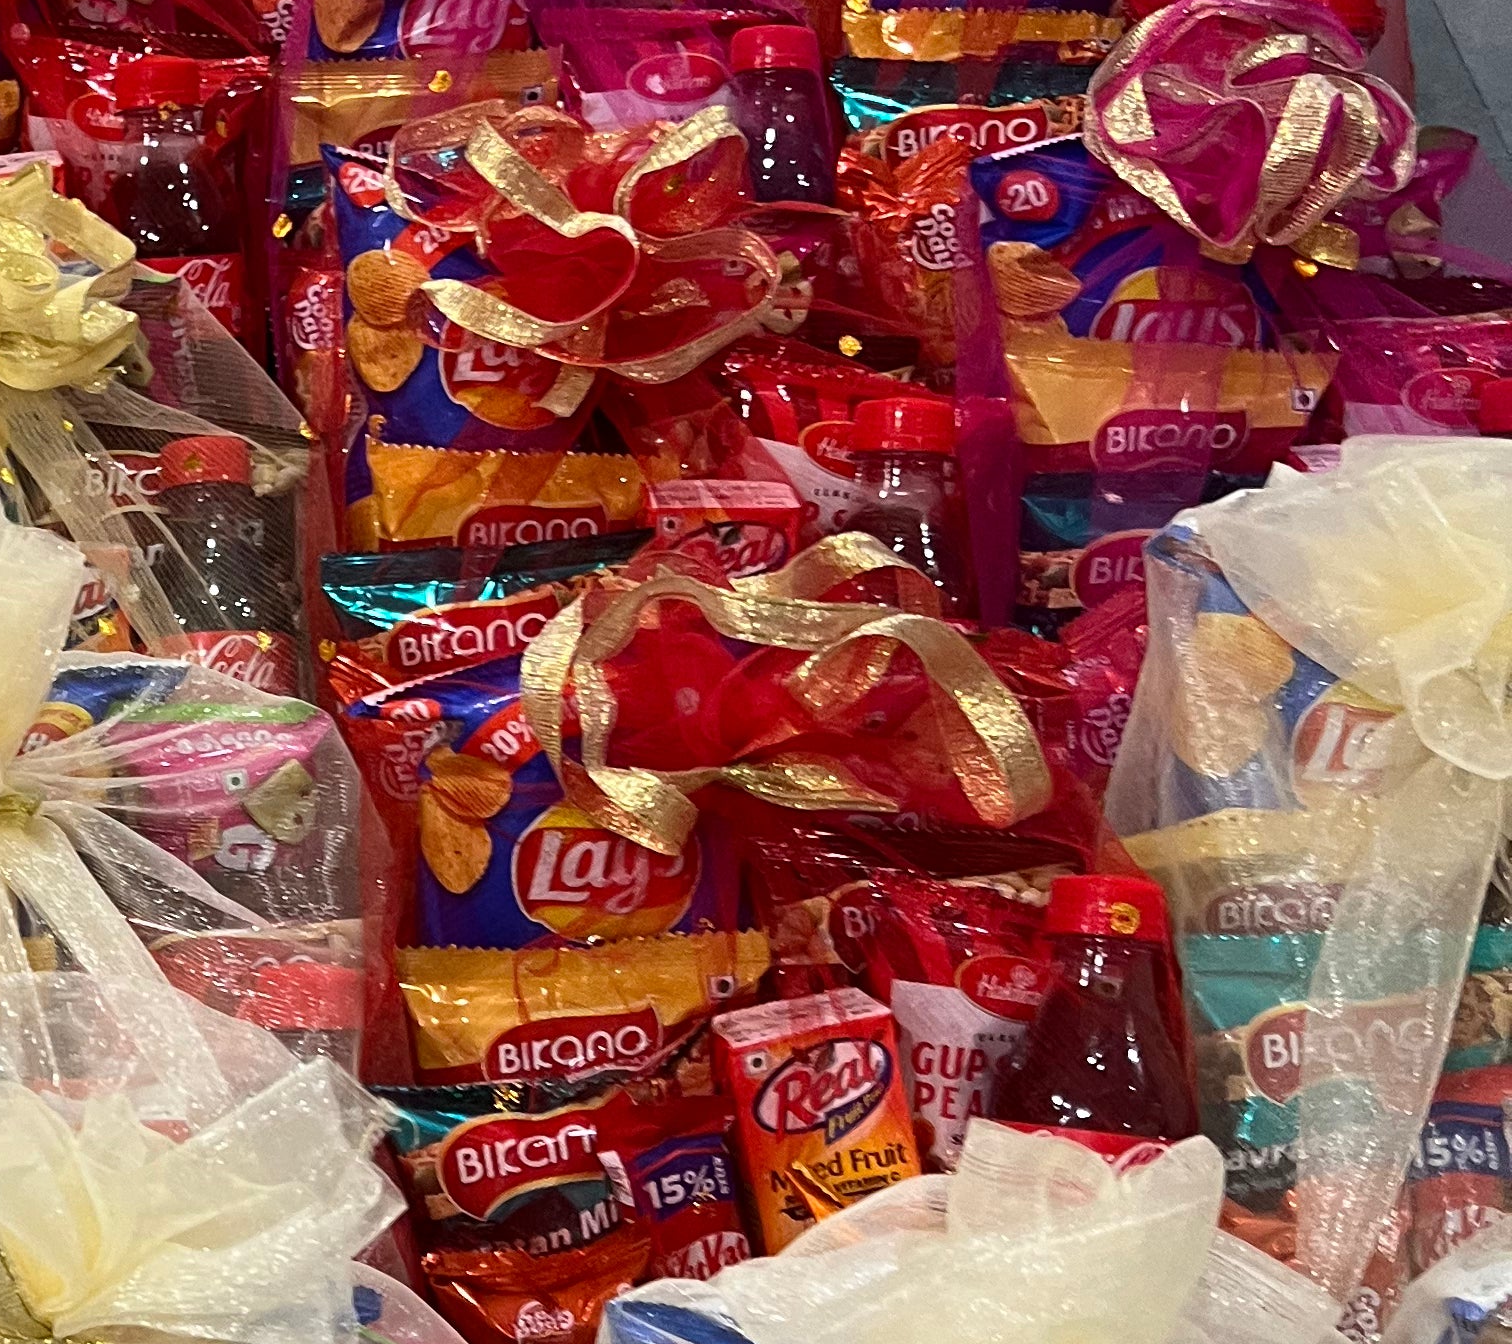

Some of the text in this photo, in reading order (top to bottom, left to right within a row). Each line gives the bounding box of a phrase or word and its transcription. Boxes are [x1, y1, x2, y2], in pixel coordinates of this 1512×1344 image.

[774, 1041, 879, 1145] Real
[850, 1141, 908, 1175] Fruit
[641, 1164, 716, 1210] 15%
